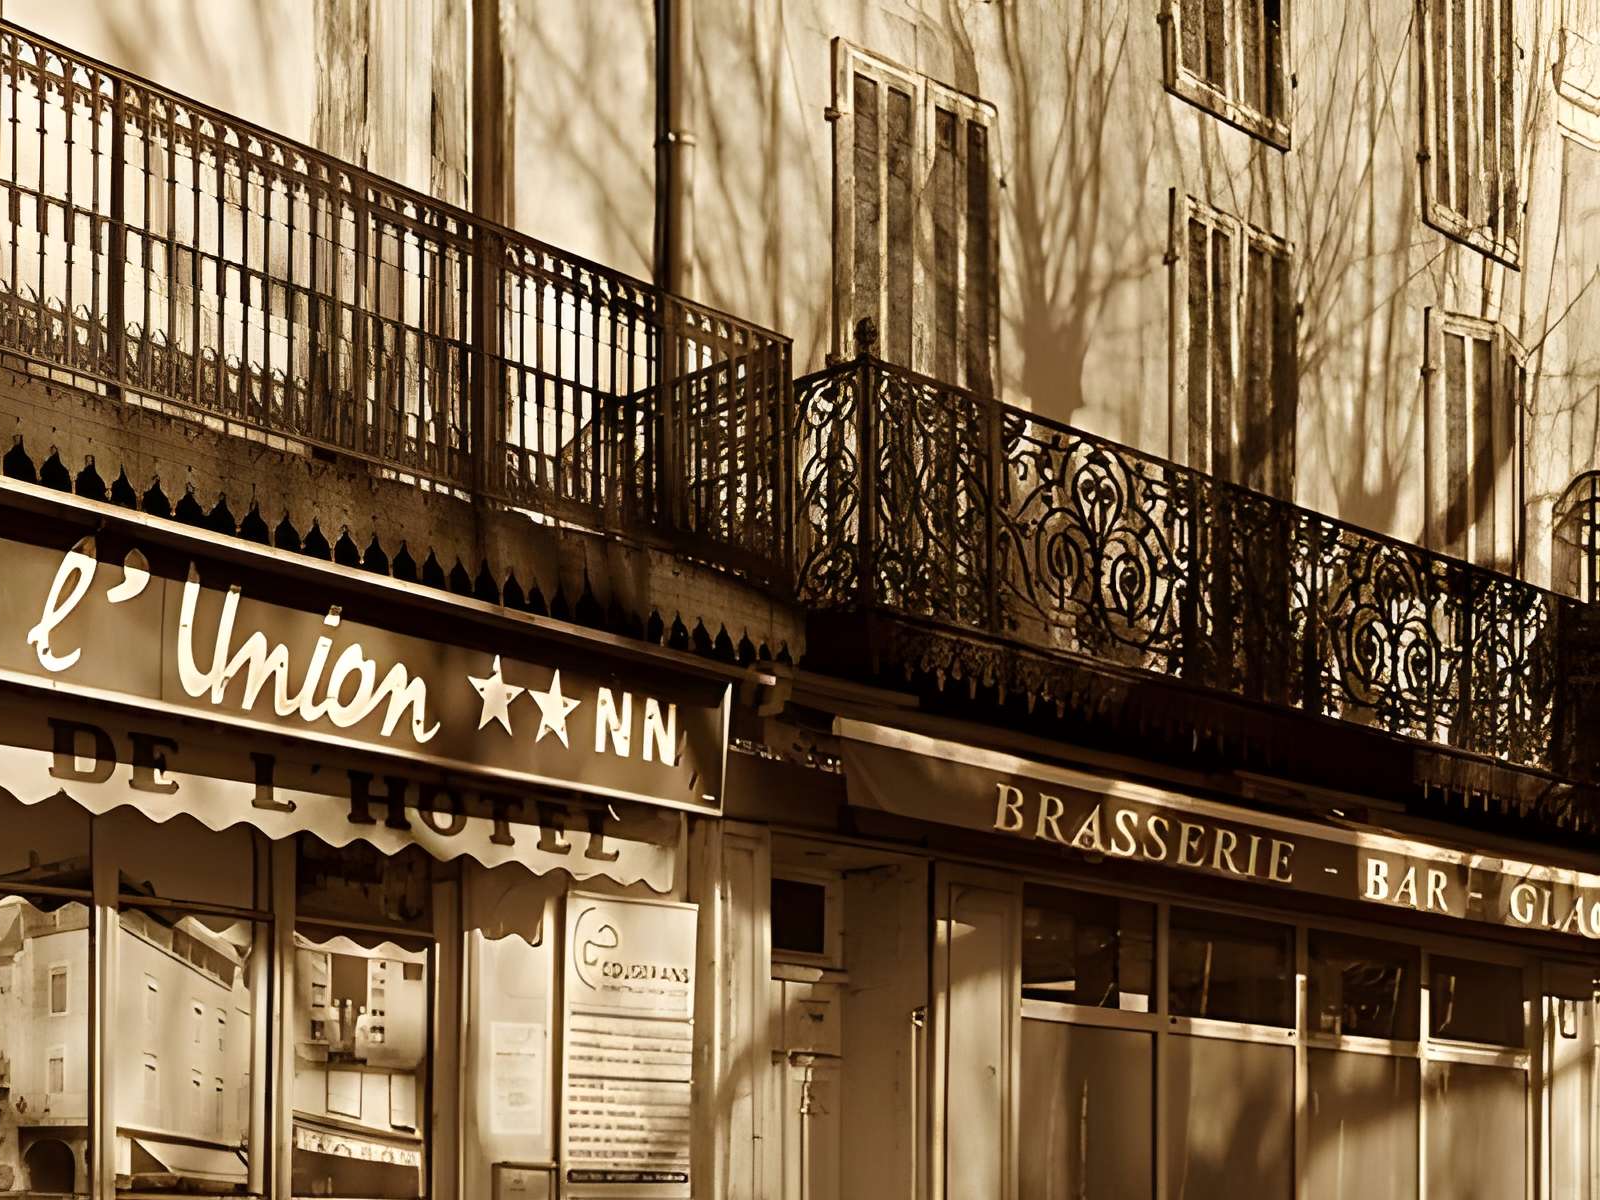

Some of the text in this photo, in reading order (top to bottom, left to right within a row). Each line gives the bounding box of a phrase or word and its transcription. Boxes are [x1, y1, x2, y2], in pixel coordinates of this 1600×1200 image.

[47, 716, 180, 795] DE
[594, 686, 679, 768] NN
[993, 783, 1295, 884] BRASSERIE
[1364, 858, 1449, 913] BAR
